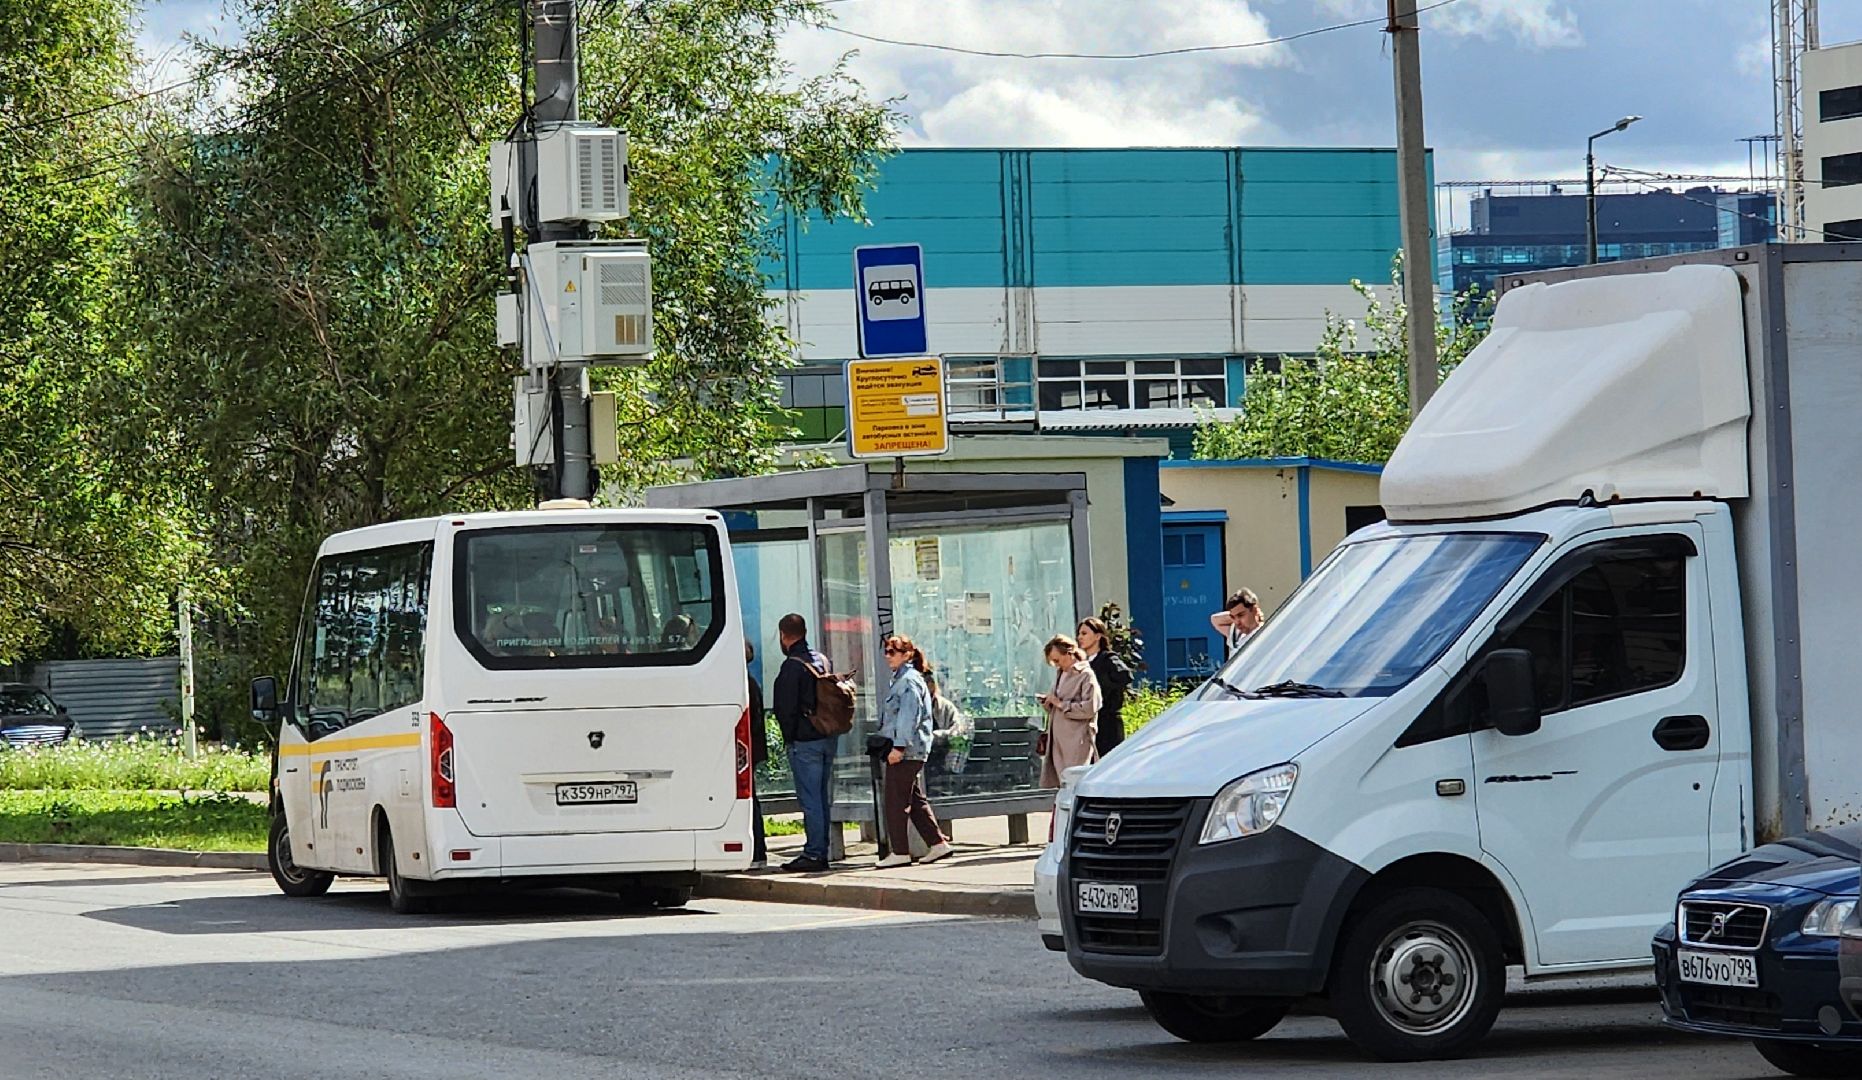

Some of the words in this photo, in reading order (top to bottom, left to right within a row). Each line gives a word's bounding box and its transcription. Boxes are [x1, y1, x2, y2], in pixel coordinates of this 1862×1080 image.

[856, 366, 893, 374] Внимание!
[856, 374, 907, 382] Круглосуточно
[857, 382, 885, 390] ведётся
[887, 381, 922, 389] эвакуация
[862, 432, 902, 440] автобусных
[874, 440, 931, 450] ЗАПРЕЩЕНА!
[496, 637, 562, 647] ПРИГЛАШАЕМ
